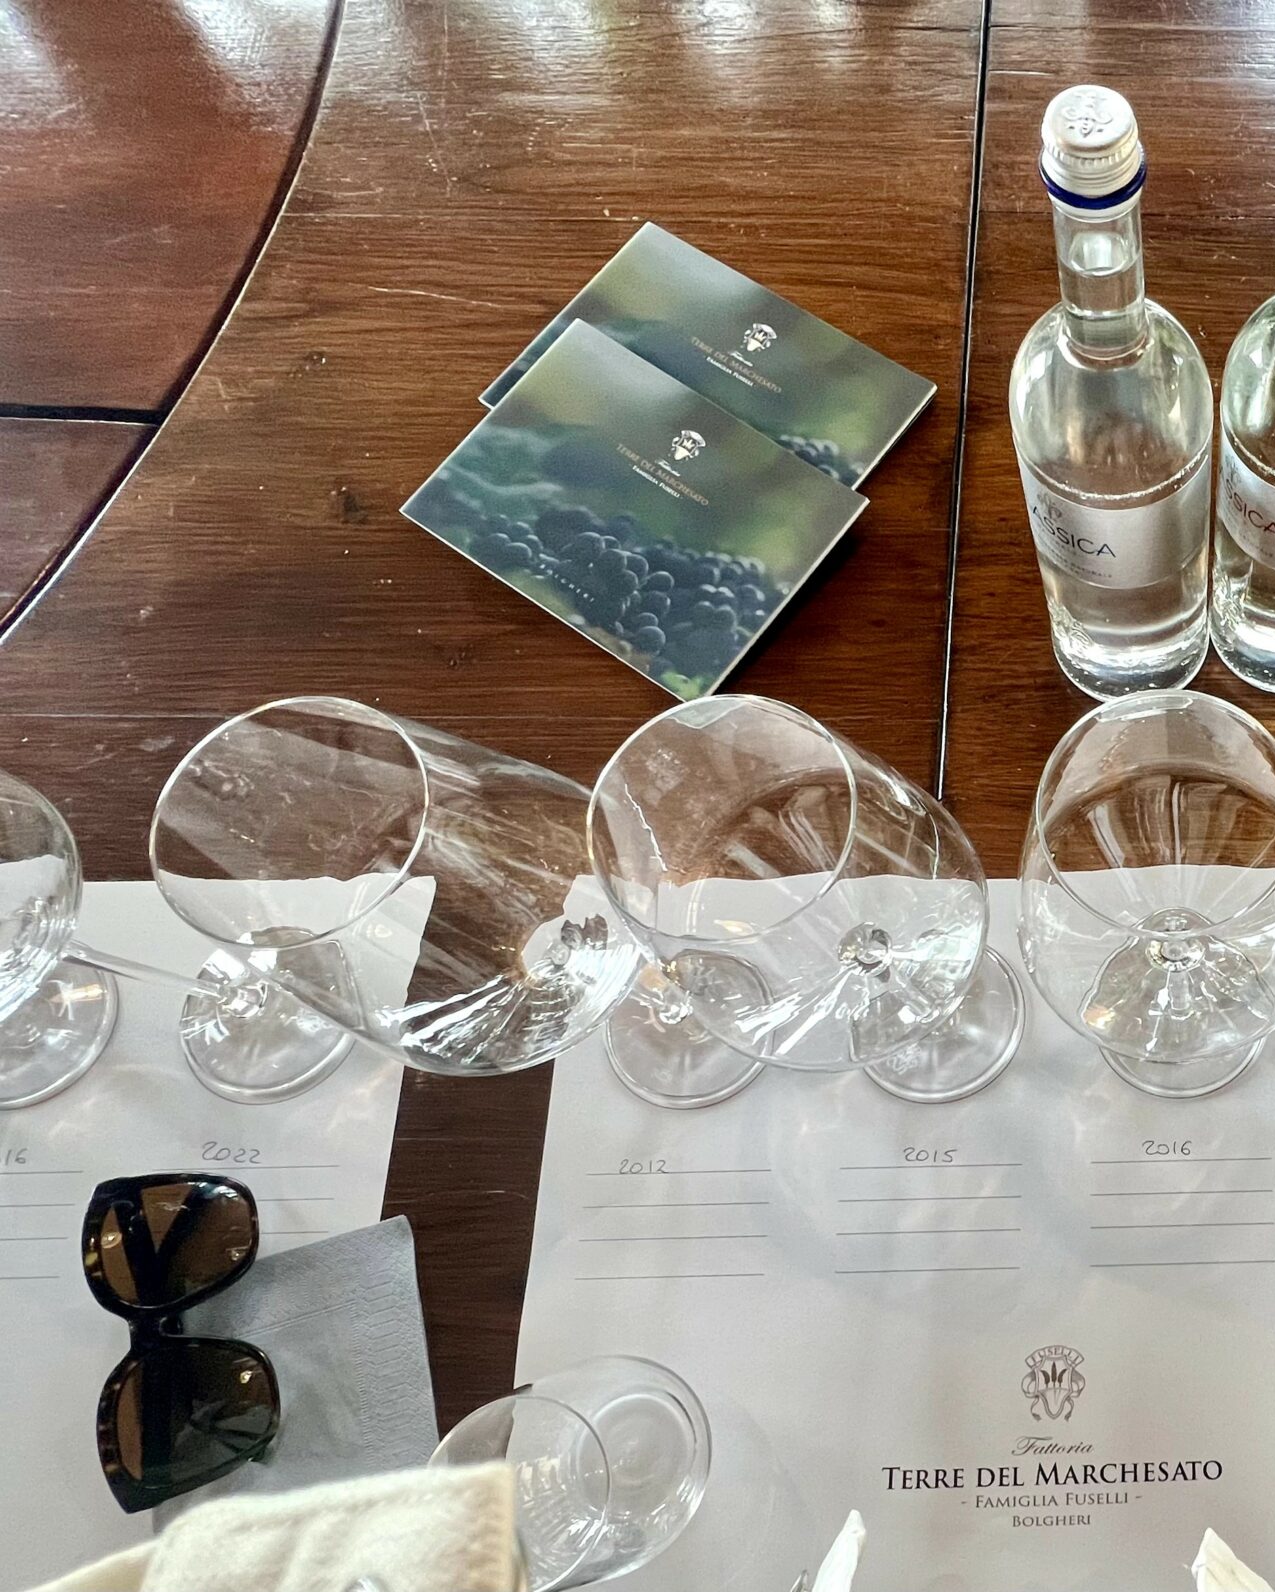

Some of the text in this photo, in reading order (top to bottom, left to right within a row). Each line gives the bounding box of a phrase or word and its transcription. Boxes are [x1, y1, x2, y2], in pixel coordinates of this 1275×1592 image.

[0, 1147, 28, 1165] 16
[202, 1141, 263, 1164] 2022
[902, 1146, 959, 1163] 2015
[1142, 1139, 1193, 1156] 2016
[618, 1158, 670, 1174] 2012
[1011, 1436, 1094, 1457] Fattoria
[882, 1460, 1223, 1491] TERRE DEL MARCHESATO
[975, 1491, 1129, 1509] FAMIGLIA FUSELLI
[1012, 1514, 1091, 1528] BOLGHERI
